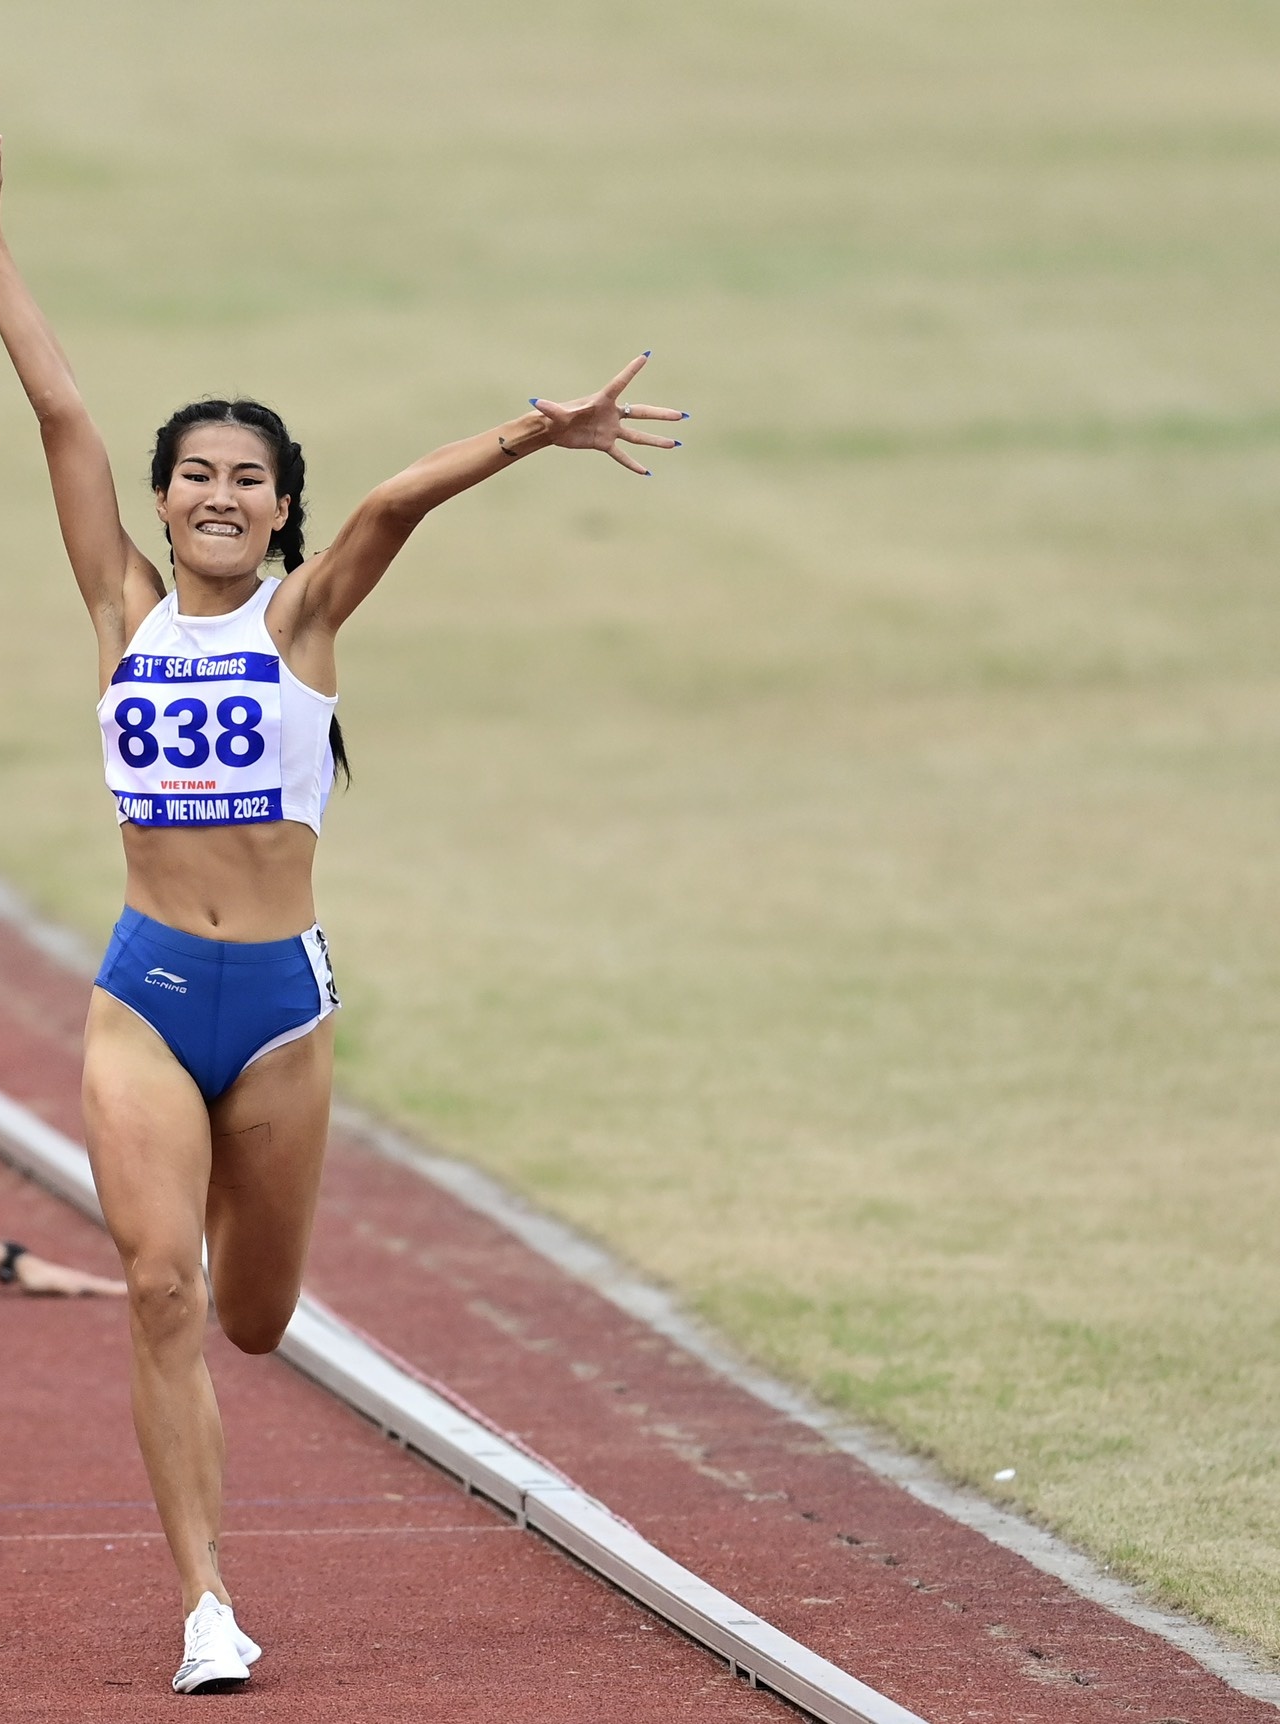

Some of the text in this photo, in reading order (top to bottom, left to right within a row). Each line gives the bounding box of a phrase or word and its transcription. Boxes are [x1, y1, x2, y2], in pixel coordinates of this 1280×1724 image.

[165, 657, 192, 678] SEA
[196, 657, 246, 677] Games
[114, 695, 265, 769] 838
[160, 780, 216, 790] VIETNAM
[166, 799, 230, 821] VIETNAM
[233, 795, 270, 819] 2022
[144, 975, 187, 994] LI-NING
